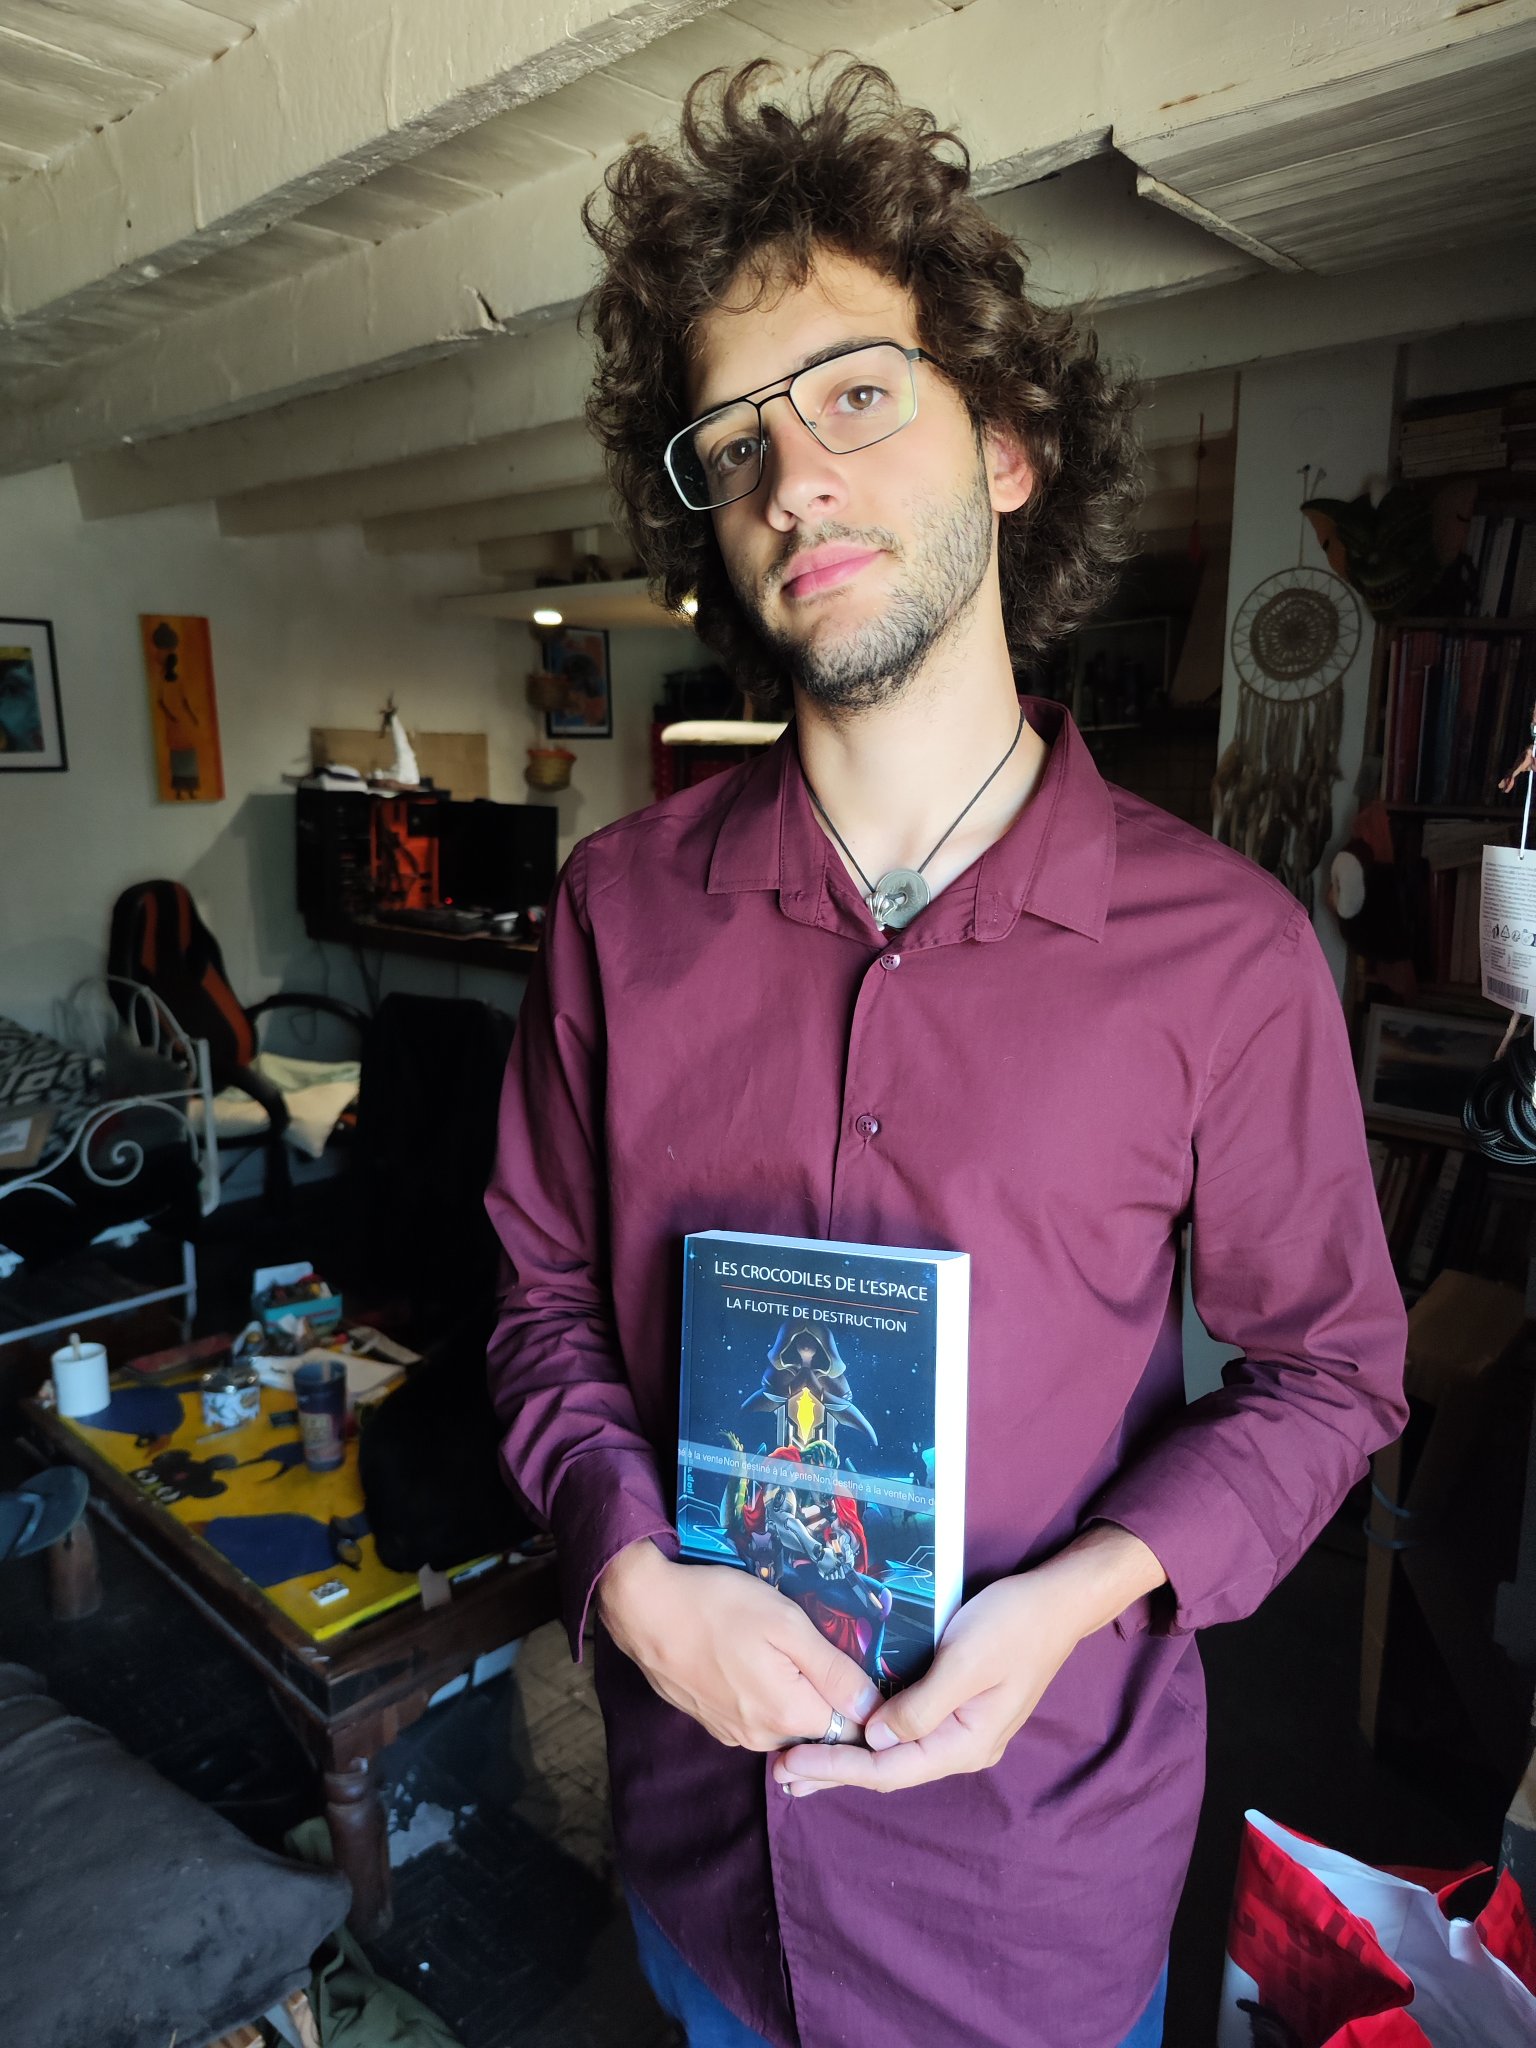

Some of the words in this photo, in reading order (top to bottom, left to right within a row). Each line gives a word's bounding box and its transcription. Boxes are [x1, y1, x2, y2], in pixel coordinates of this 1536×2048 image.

[714, 1260, 738, 1277] LES
[740, 1263, 831, 1289] CROCODILES
[835, 1276, 856, 1293] DE
[859, 1279, 928, 1302] L'ESPACE
[725, 1296, 742, 1310] LA
[744, 1299, 790, 1317] FLOTTE
[792, 1305, 810, 1320] DE
[812, 1308, 907, 1334] DESTRUCTION
[693, 1449, 702, 1460] la
[741, 1460, 771, 1473] destiné
[772, 1466, 779, 1476] à
[780, 1467, 788, 1478] la
[832, 1478, 865, 1492] destiné
[866, 1484, 872, 1494] à
[873, 1485, 882, 1496] la
